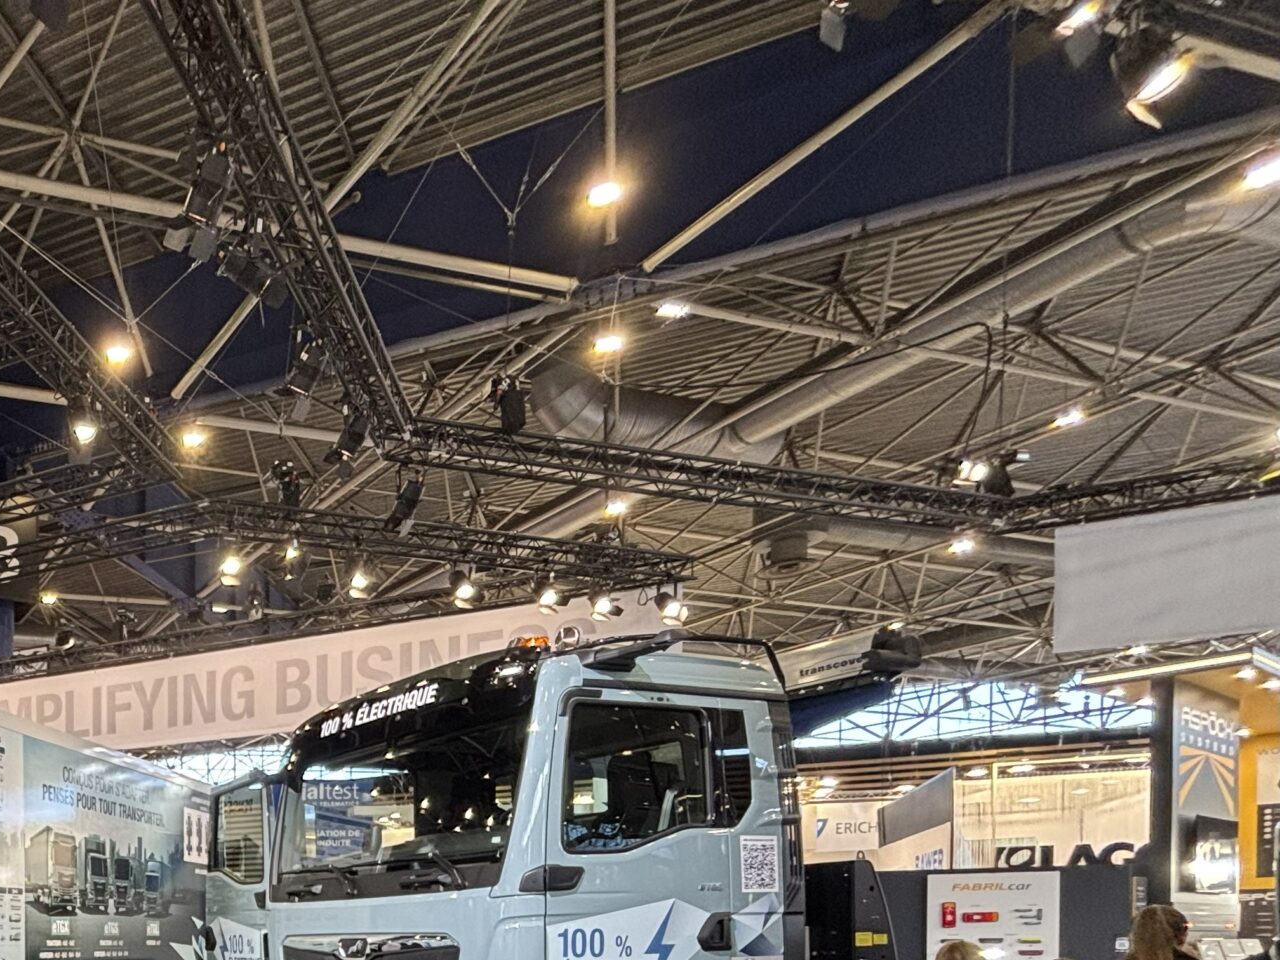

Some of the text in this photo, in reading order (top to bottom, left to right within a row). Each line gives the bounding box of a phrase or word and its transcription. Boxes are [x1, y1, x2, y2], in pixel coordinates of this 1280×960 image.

[320, 683, 439, 738] 100 % ÉLECTRIQUE
[95, 775, 114, 795] POUR
[42, 783, 75, 807] PENSÉS
[76, 792, 97, 811] POUR
[99, 798, 117, 817] TOUT
[952, 882, 1032, 891] FABRILcar
[228, 934, 243, 954] 100
[558, 928, 632, 958] 100 %
